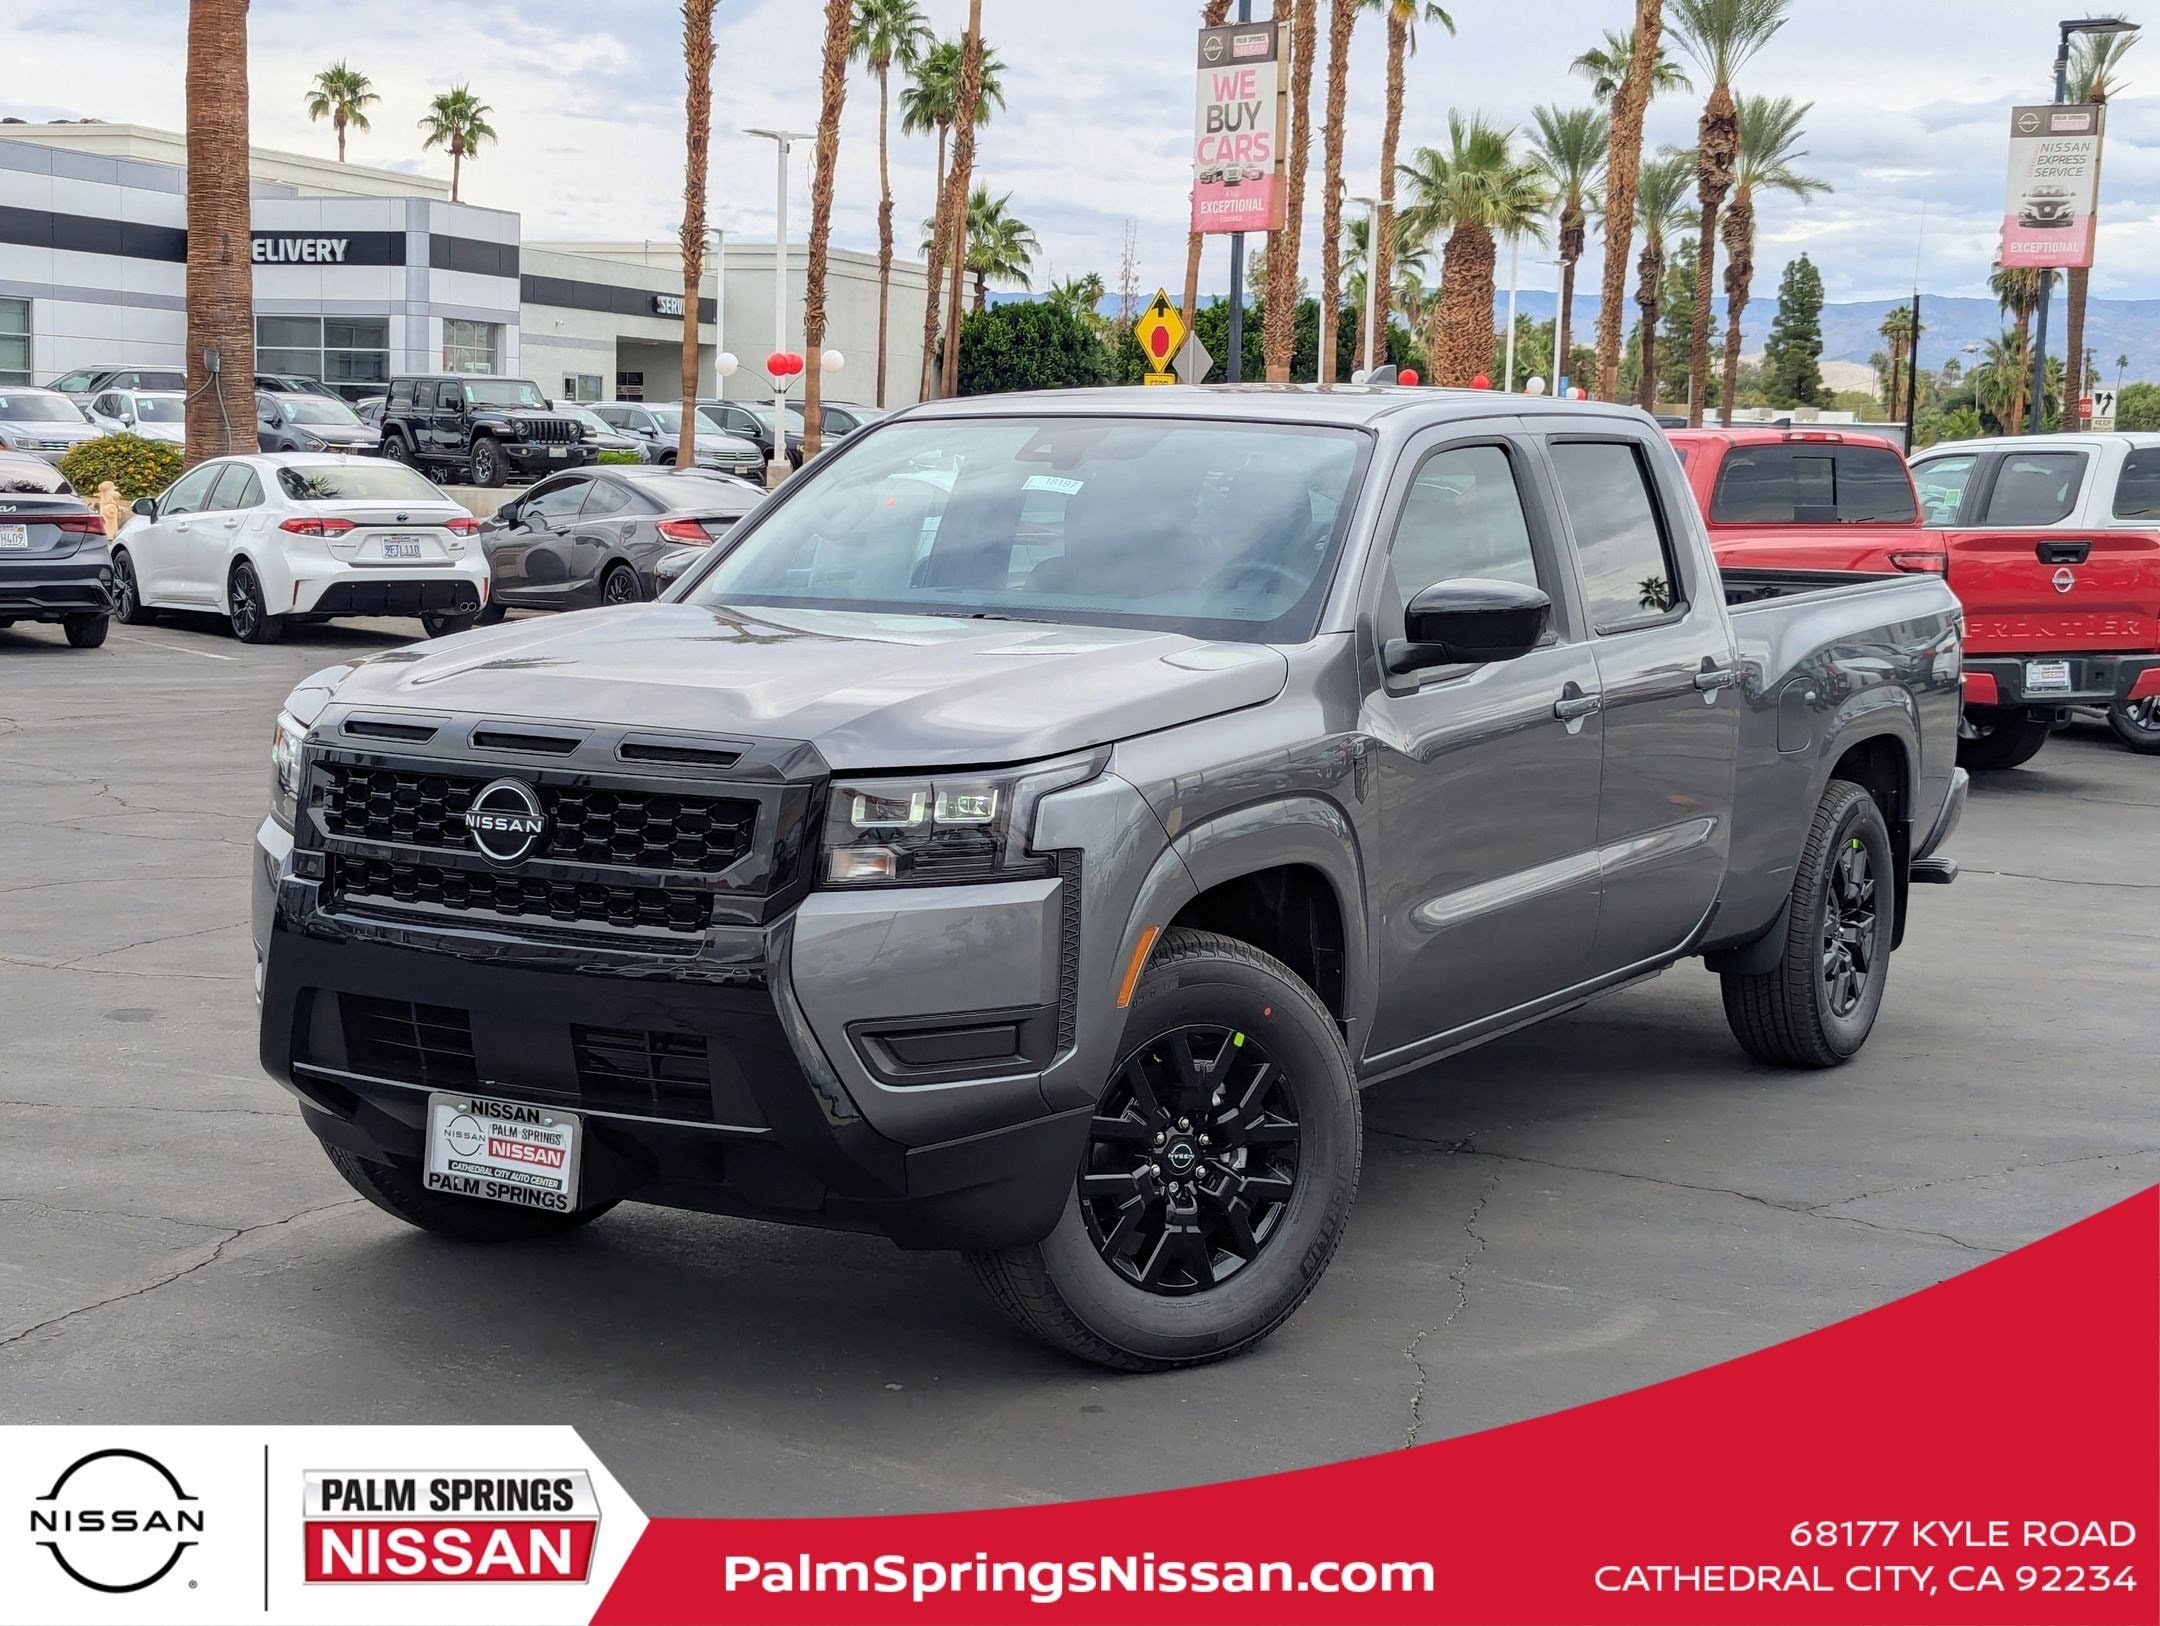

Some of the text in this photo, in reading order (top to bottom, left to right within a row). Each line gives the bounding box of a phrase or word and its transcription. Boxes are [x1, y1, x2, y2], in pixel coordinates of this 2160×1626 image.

[1213, 69, 1256, 102] WE
[1207, 101, 1263, 134] BUY
[1197, 132, 1270, 165] CARS
[2040, 142, 2091, 153] NISSAN
[2037, 155, 2087, 165] EXPRESS
[2034, 167, 2084, 177] SERVICE
[1200, 198, 1264, 214] EXCEPTIONAL
[252, 239, 349, 262] ELIVERY
[2010, 241, 2081, 253] EXCEPTIONAL
[656, 295, 684, 315] SERV
[1962, 615, 2142, 638] FRONTIER
[465, 814, 542, 833] NISSAN
[470, 1100, 540, 1124] NISSAN
[444, 1129, 486, 1142] NISSAN
[492, 1124, 562, 1146] PALM SPRINGS
[492, 1141, 561, 1167] NISSAN
[451, 1162, 559, 1188] CATHEDRAL CITY AUTO CENTER
[428, 1173, 568, 1210] PALM SPRINGS
